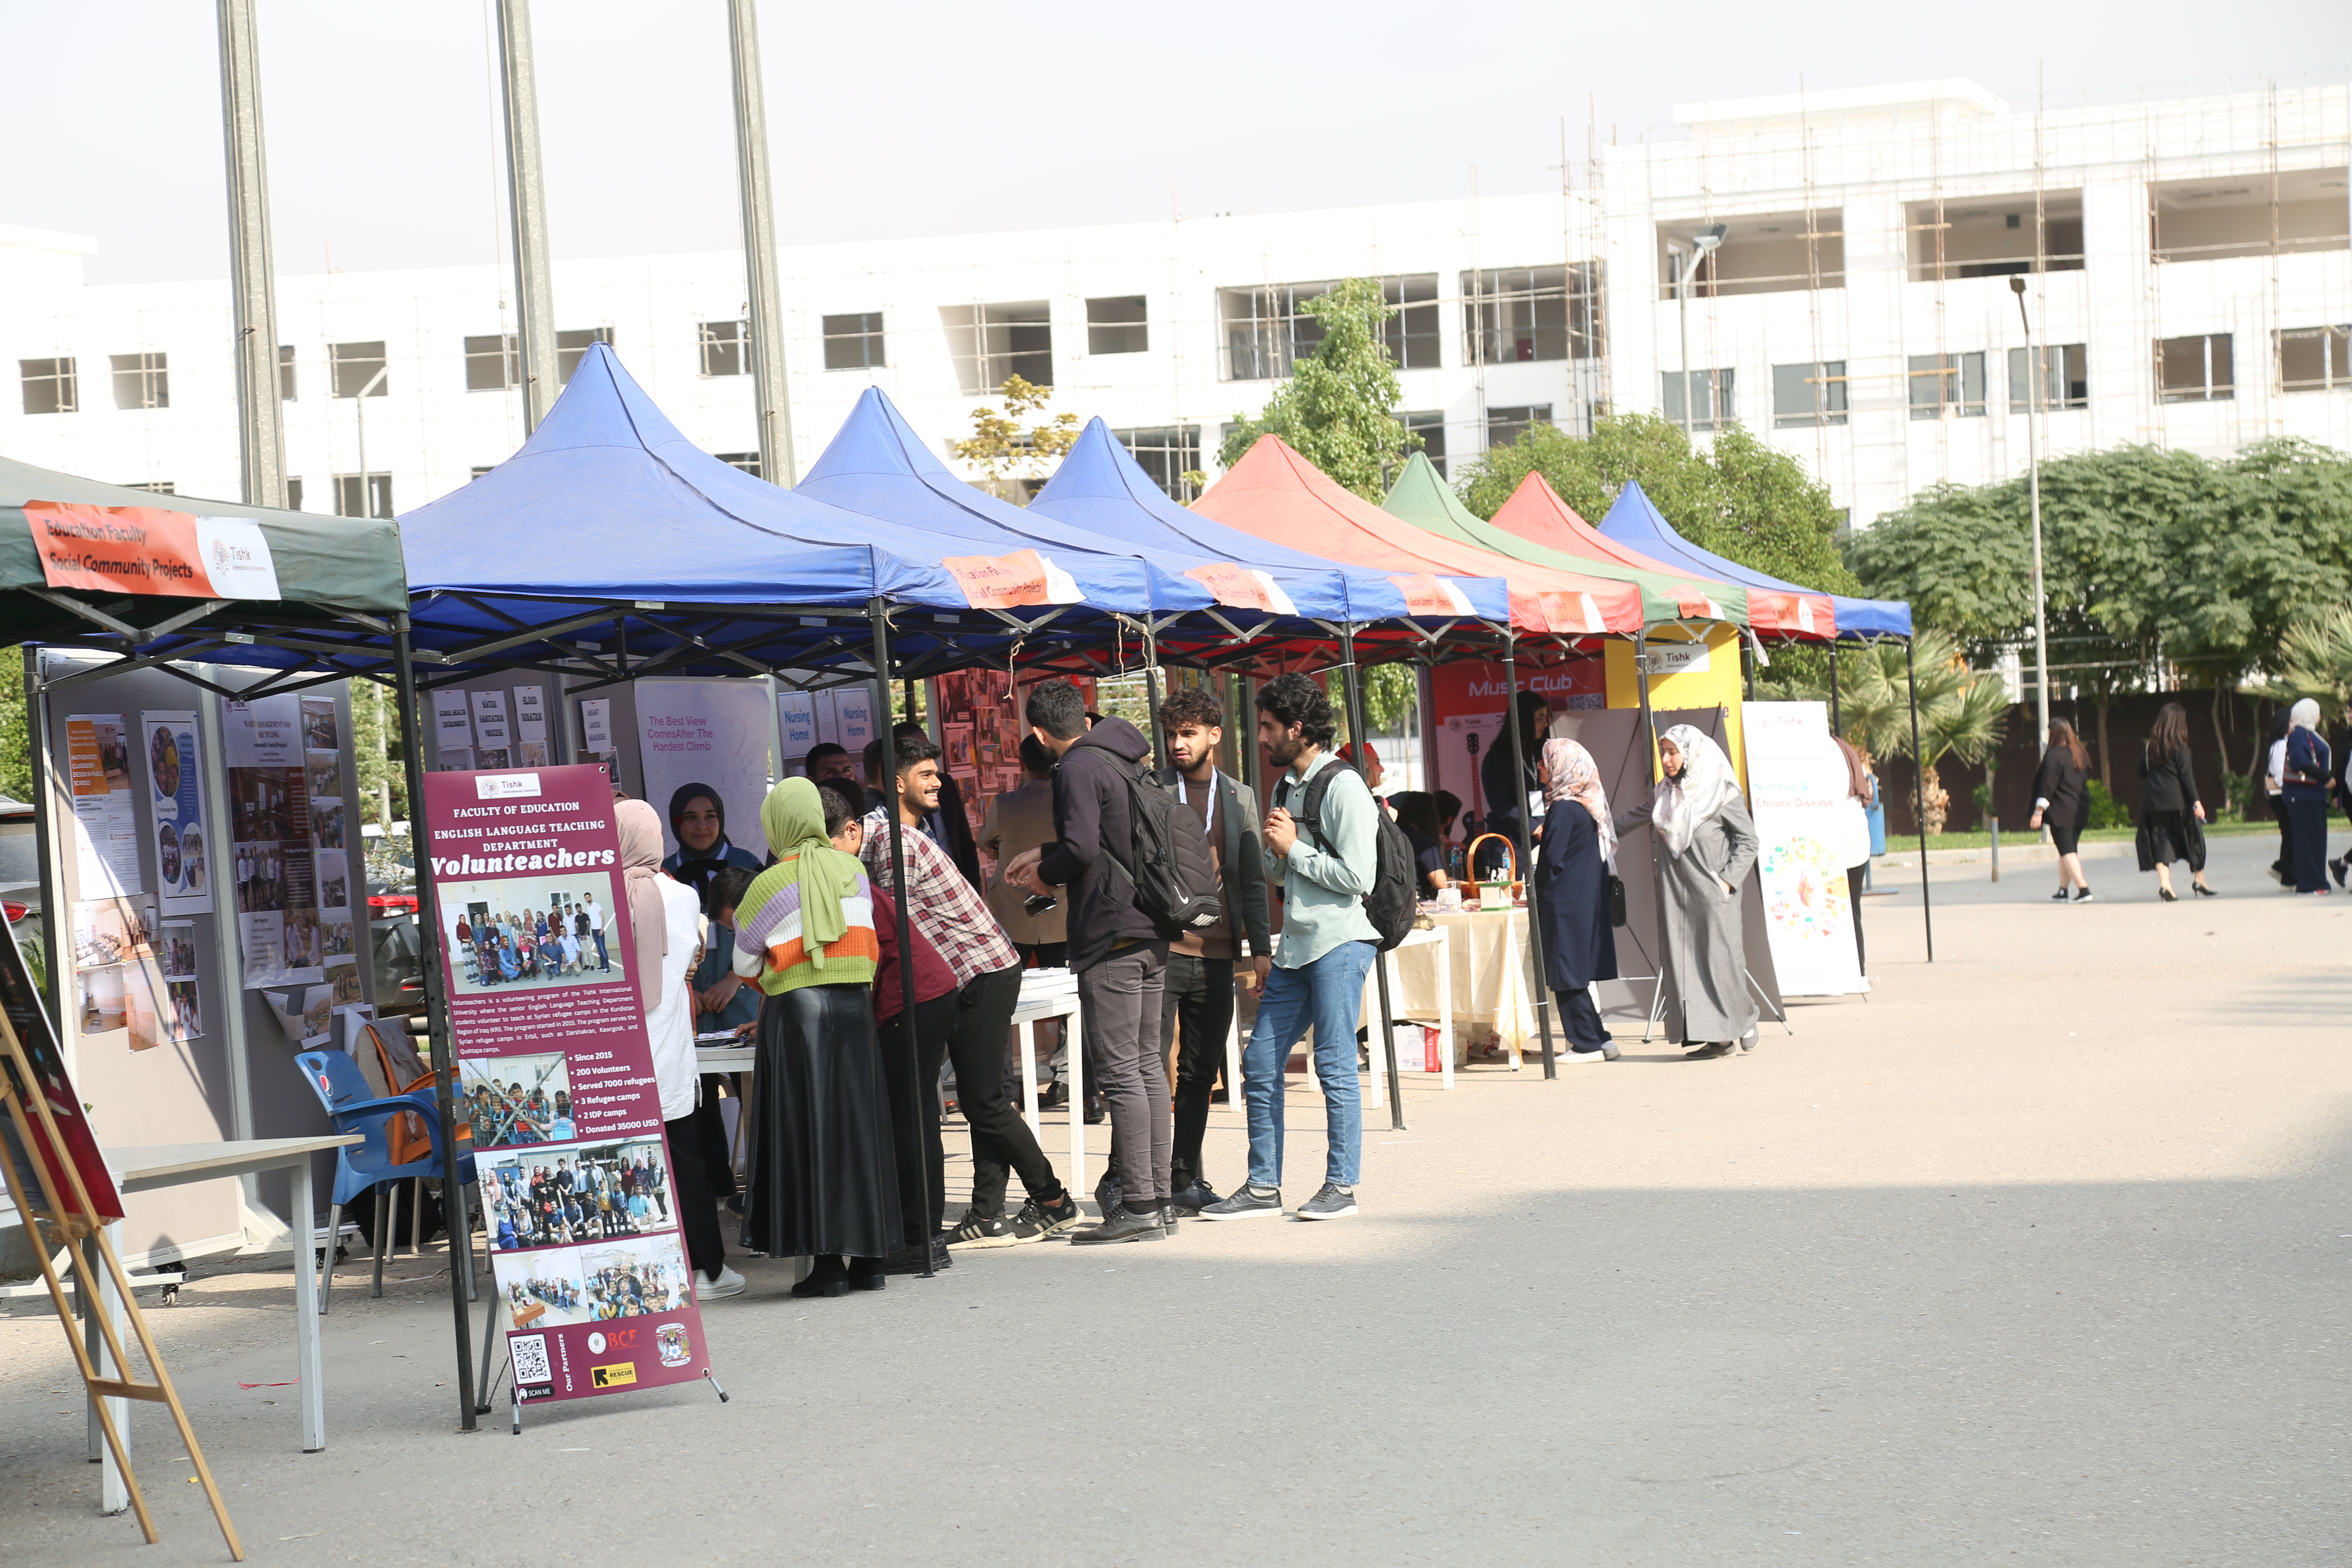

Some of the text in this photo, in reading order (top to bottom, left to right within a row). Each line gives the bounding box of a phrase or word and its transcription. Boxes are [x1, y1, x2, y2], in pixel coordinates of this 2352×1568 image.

[44, 519, 146, 546] Education Faculty
[229, 546, 252, 561] Tishk
[50, 552, 192, 580] Social Community Projects
[968, 581, 1042, 599] Social Community Projects
[1666, 652, 1690, 662] Tishk
[1469, 674, 1572, 697] Musc Club
[784, 709, 811, 725] Nursing
[844, 706, 867, 721] Nursing
[649, 716, 706, 726] The Best View
[1778, 716, 1802, 725] Tishk
[648, 728, 713, 738] ComesAfter The
[789, 728, 809, 741] Home
[847, 724, 865, 736] Home
[653, 741, 711, 751] Hardest Climb
[1754, 782, 1808, 791] Nutrition &
[1756, 797, 1833, 808] Chronic Disease
[453, 802, 579, 818] FACULTY OF EDUCATION
[434, 820, 605, 840] ENGLISH LANGUAGE TEACHING
[482, 838, 558, 852] DEPARTMENT
[430, 847, 615, 876] Volunteachers
[599, 1025, 625, 1033] Kawrgosk,
[574, 1051, 613, 1062] Since 2015
[576, 1065, 631, 1076] 200 Volunteers
[578, 1077, 655, 1091] Served 7000 refugees
[587, 1095, 616, 1105] Refugee
[617, 1093, 641, 1101] camps
[589, 1110, 602, 1119] IDP
[603, 1109, 627, 1118] camps
[585, 1118, 659, 1134] Donated 35000 USD
[608, 1329, 637, 1348] BCF
[558, 1333, 570, 1373] Partners
[610, 1370, 633, 1378] RESCUE
